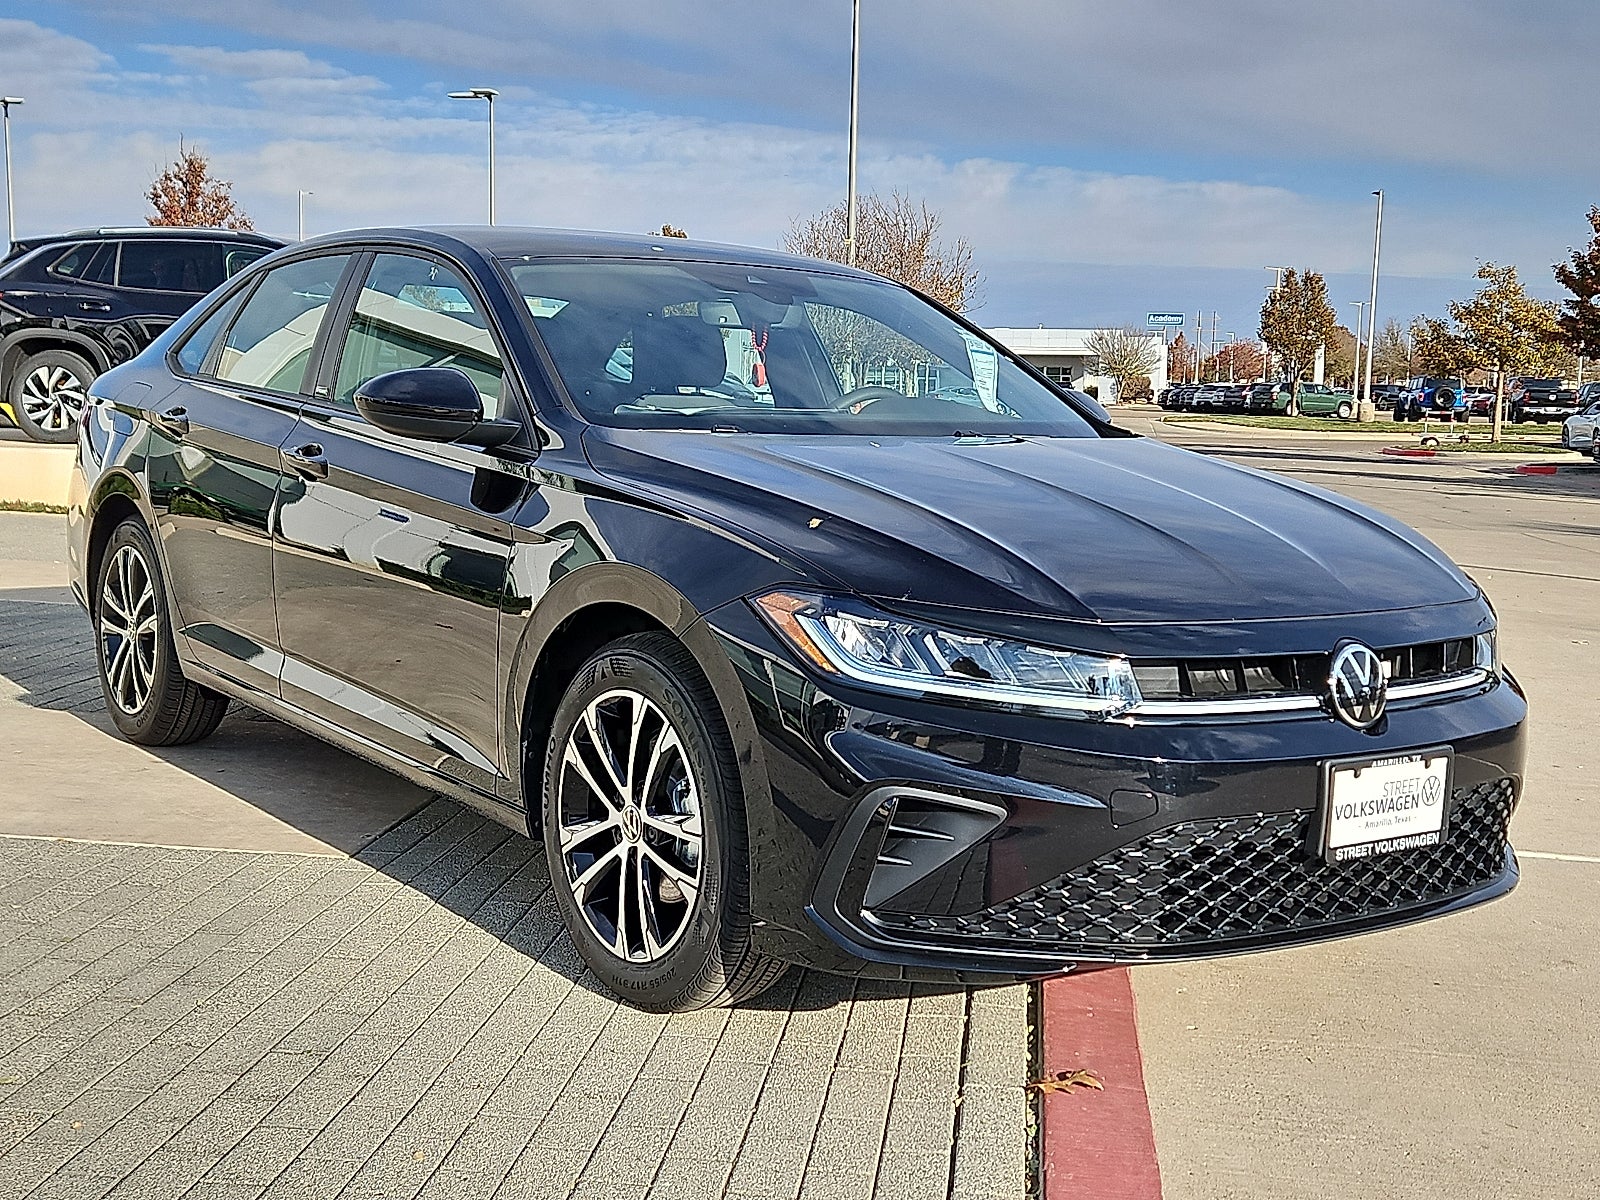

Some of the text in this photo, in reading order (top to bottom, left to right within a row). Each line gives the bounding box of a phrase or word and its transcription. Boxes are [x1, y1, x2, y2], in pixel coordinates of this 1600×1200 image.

[1149, 314, 1183, 324] Academy
[1383, 777, 1421, 798] STREET
[1335, 793, 1420, 821] VOLKSWAGEN
[1335, 831, 1440, 862] STREET VOLKSWAGEN
